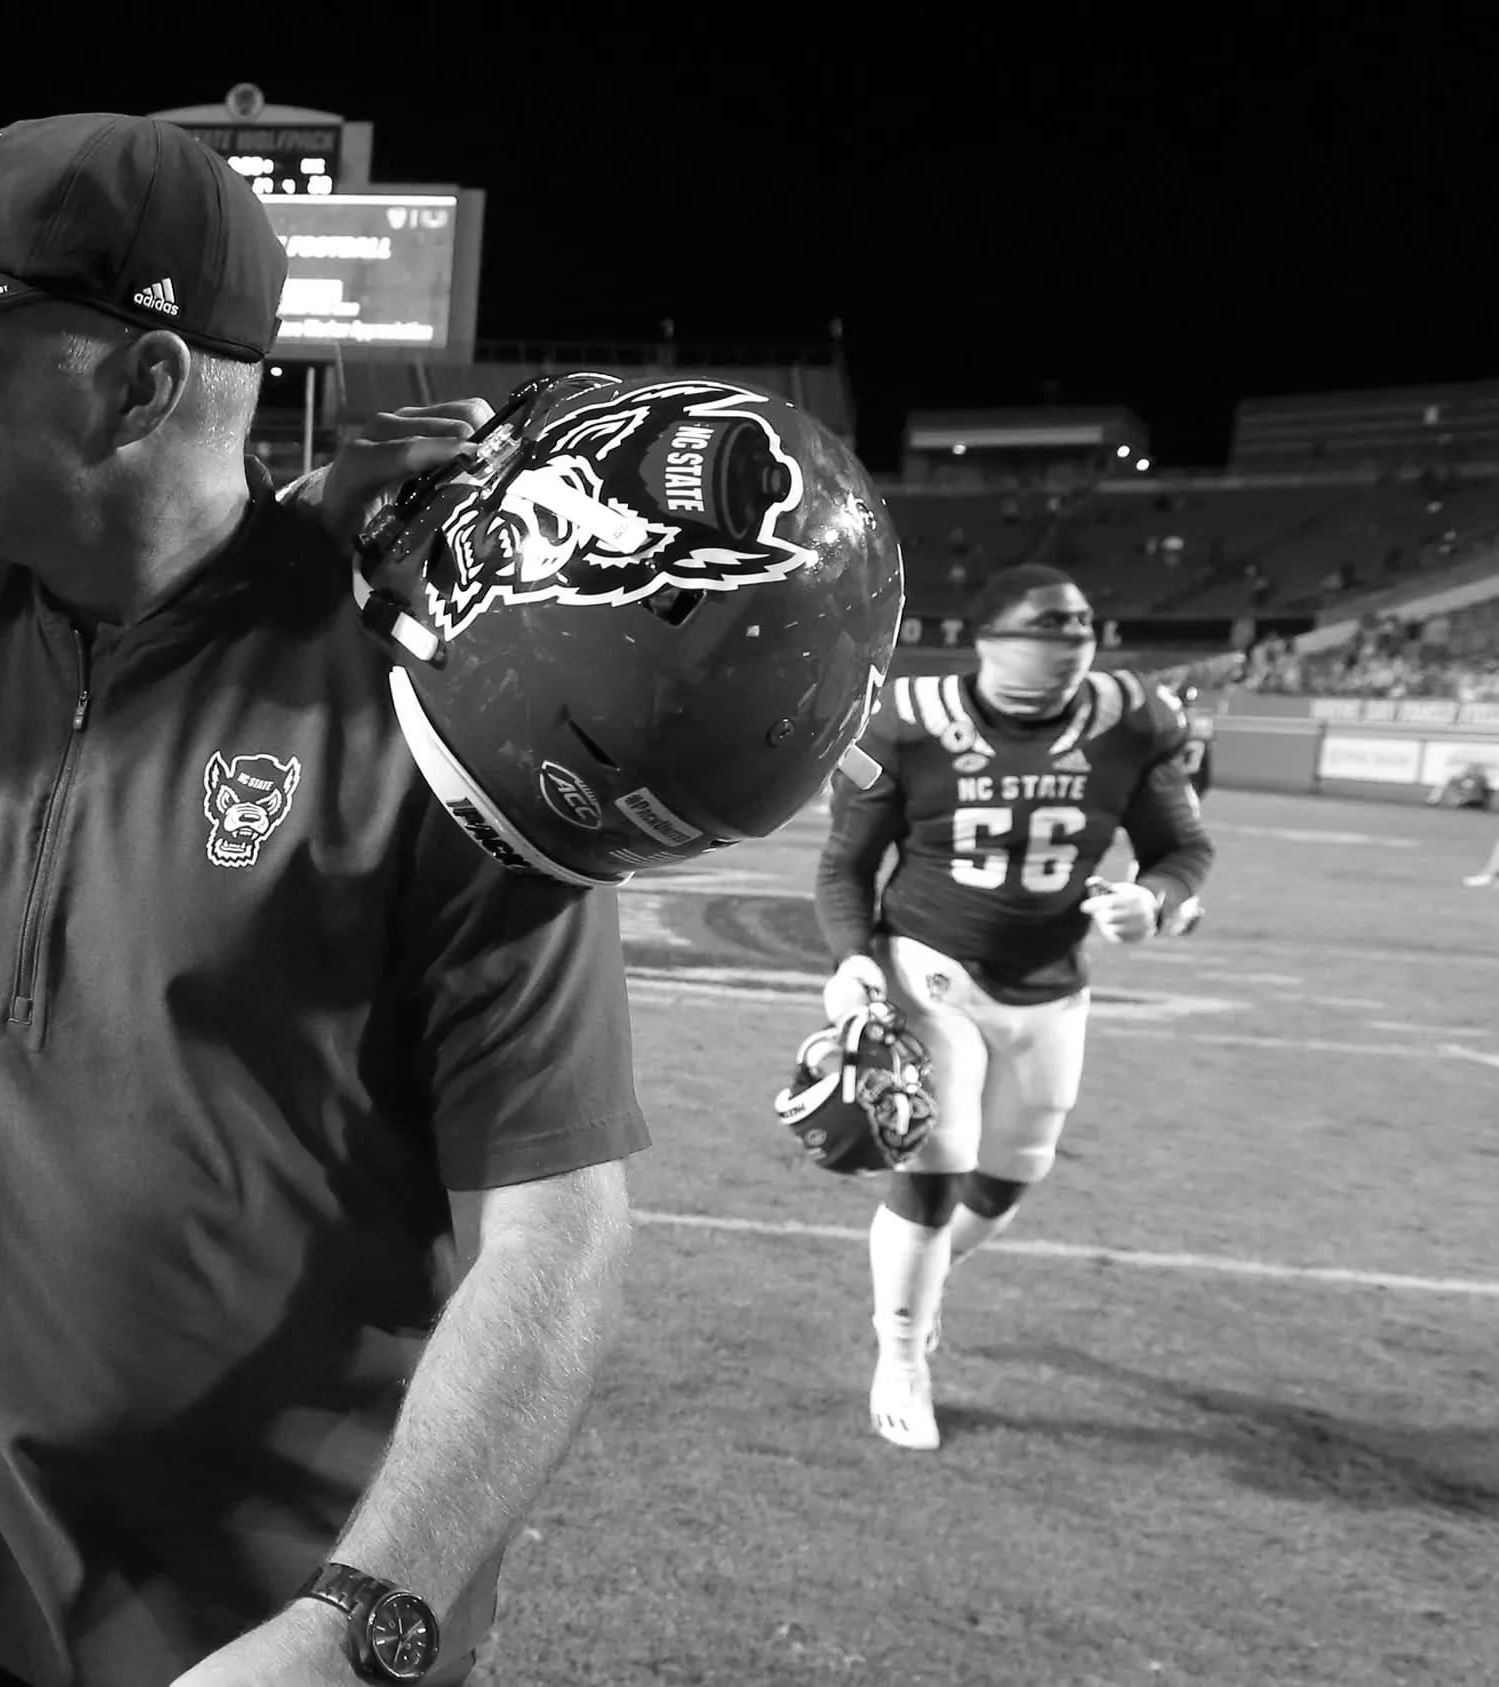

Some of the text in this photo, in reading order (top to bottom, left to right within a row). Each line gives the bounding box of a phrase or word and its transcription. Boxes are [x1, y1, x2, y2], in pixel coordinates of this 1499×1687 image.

[133, 291, 179, 316] adidas
[664, 425, 714, 511] NC STATE
[247, 777, 274, 791] STATE
[547, 772, 598, 821] ACC
[957, 774, 1088, 801] NC STATE
[950, 806, 1086, 893] 56
